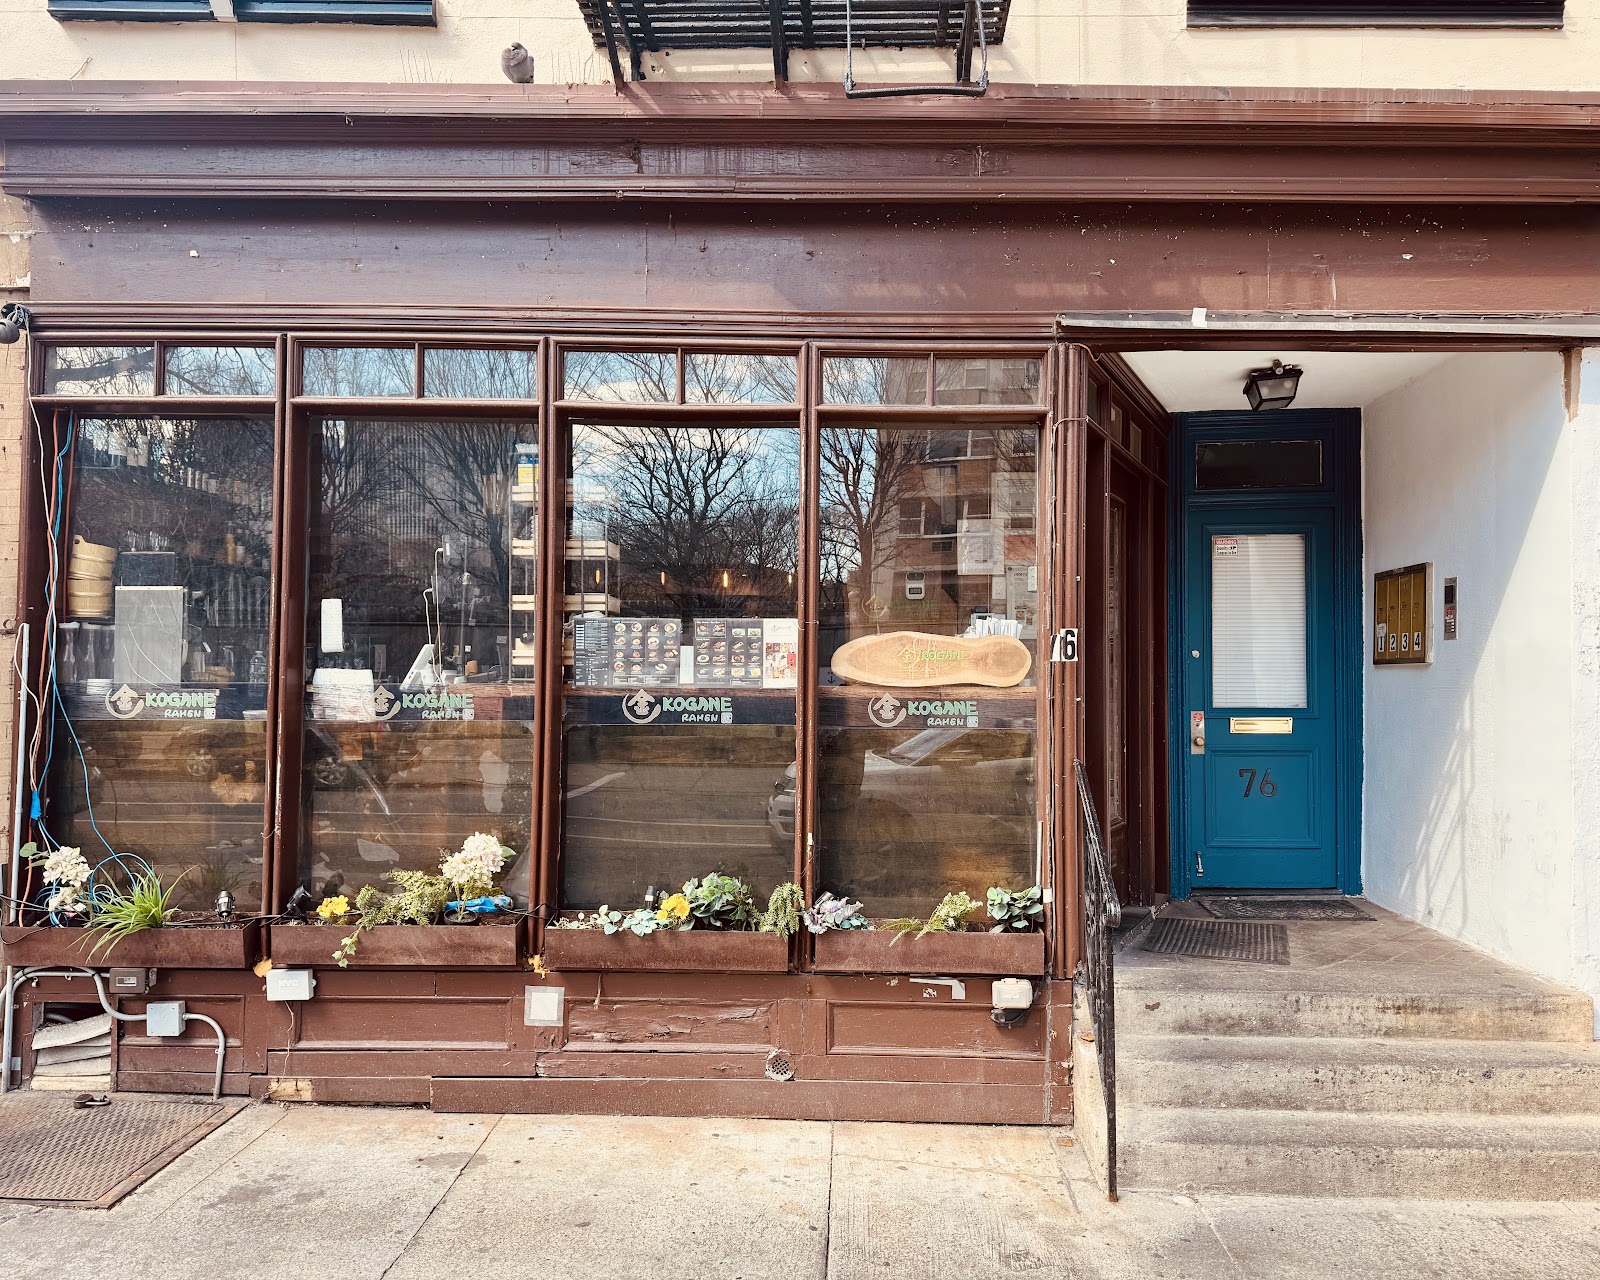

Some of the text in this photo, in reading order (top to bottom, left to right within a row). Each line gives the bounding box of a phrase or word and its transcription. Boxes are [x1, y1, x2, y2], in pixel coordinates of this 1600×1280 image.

[1391, 635, 1396, 650] 2
[1402, 634, 1408, 650] 3
[1414, 633, 1420, 649] 4
[145, 692, 216, 708] KOGANE
[402, 693, 474, 708] KOGANE
[662, 697, 733, 712] KOGANE
[164, 709, 201, 718] RAMEN
[422, 709, 460, 719] RAMEN
[907, 700, 979, 716] KOGANE
[681, 713, 718, 722] RAMEN
[927, 717, 964, 726] RAMEN
[1239, 768, 1278, 798] 76
